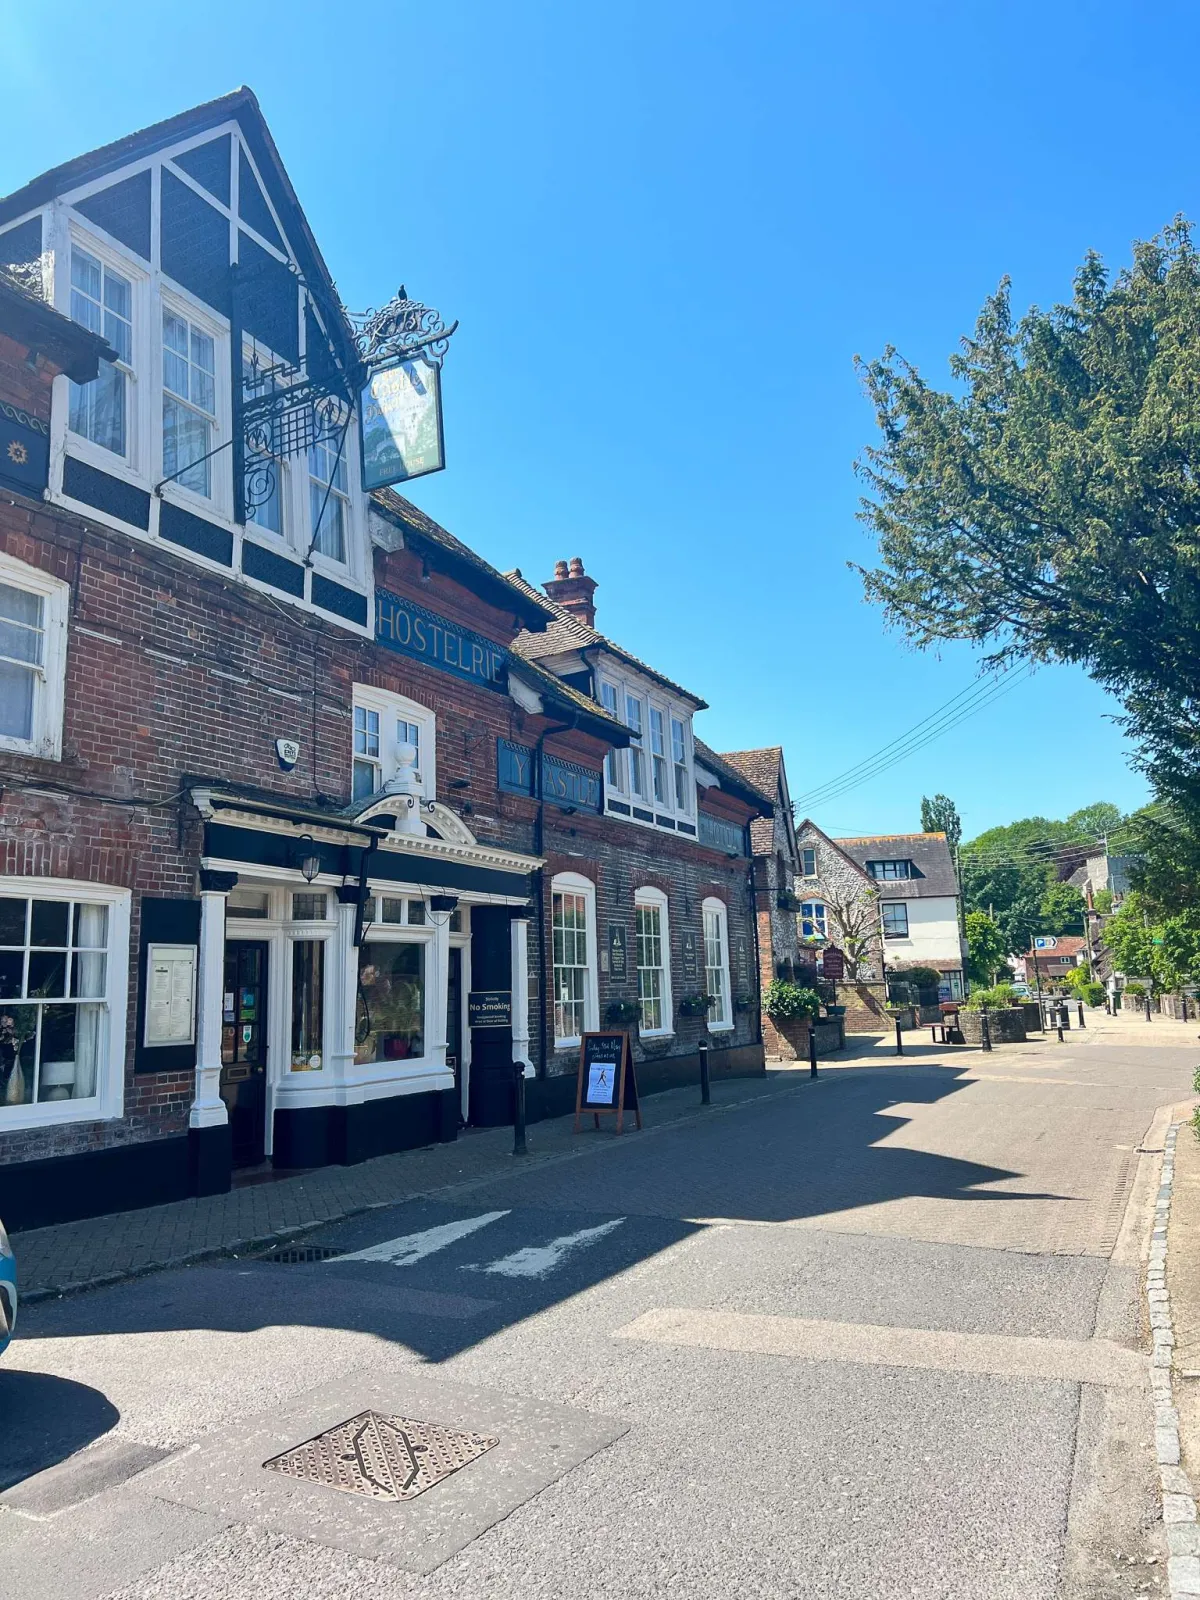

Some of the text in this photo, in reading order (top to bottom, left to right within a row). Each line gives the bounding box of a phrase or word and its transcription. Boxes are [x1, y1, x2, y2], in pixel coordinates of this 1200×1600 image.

[377, 599, 503, 684] HOSTELRIE
[534, 763, 598, 807] ASTLE
[470, 1002, 511, 1012] No Smoking
